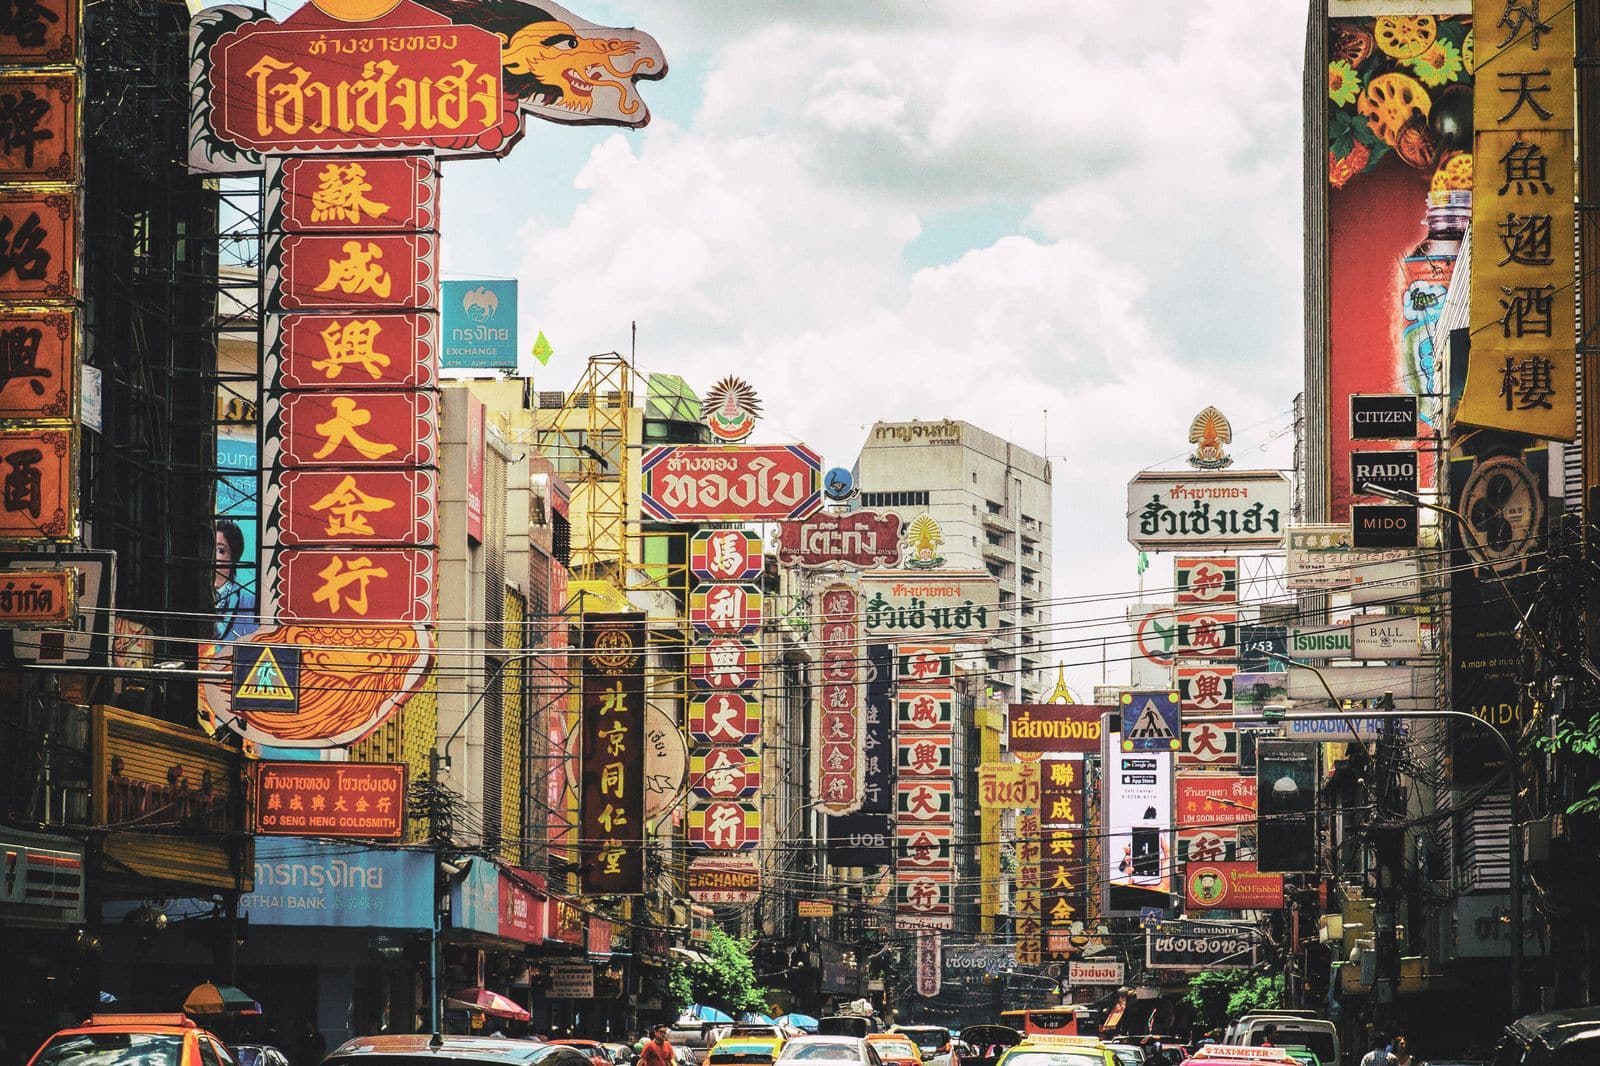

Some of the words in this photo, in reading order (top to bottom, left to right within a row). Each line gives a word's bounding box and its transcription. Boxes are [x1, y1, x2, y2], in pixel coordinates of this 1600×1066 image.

[308, 34, 458, 56] ห้างขายทอง
[452, 325, 509, 345] กรุงไทย
[446, 347, 498, 356] EXCHANGE
[309, 163, 397, 615] 蘇成興大金行
[1355, 410, 1413, 424] CITIZEN
[666, 452, 738, 471] ห้างทอง
[1356, 463, 1414, 477] RADO
[661, 456, 805, 508] ทองใบ
[1170, 484, 1248, 500] ห้างขายทอง
[1139, 494, 1280, 536] ฮั่วเซ่งเฮง
[1363, 517, 1408, 529] MIDO
[800, 522, 877, 555] โต๊ะกัง
[892, 584, 961, 597] ห้างขายทอง
[865, 592, 988, 629] ฮั่วเซ่งเฮง
[1370, 627, 1403, 637] BALL
[1461, 661, 1467, 669] A
[707, 533, 745, 847] 馬利興大金行
[1293, 719, 1362, 734] BROADWAY
[264, 772, 330, 791] ห้างขายทอง
[598, 681, 627, 874] 北京同仁堂
[908, 653, 941, 909] 和成興大金行
[267, 793, 392, 813] 蘇成興大金行
[263, 816, 277, 825] SO
[280, 816, 306, 827] SENG
[309, 816, 336, 827] HENG
[339, 817, 396, 829] GOLDSMITH
[1196, 814, 1216, 822] SOON
[850, 833, 885, 847] UOB
[689, 872, 758, 887] EXCHANGE
[288, 897, 326, 909] BANK
